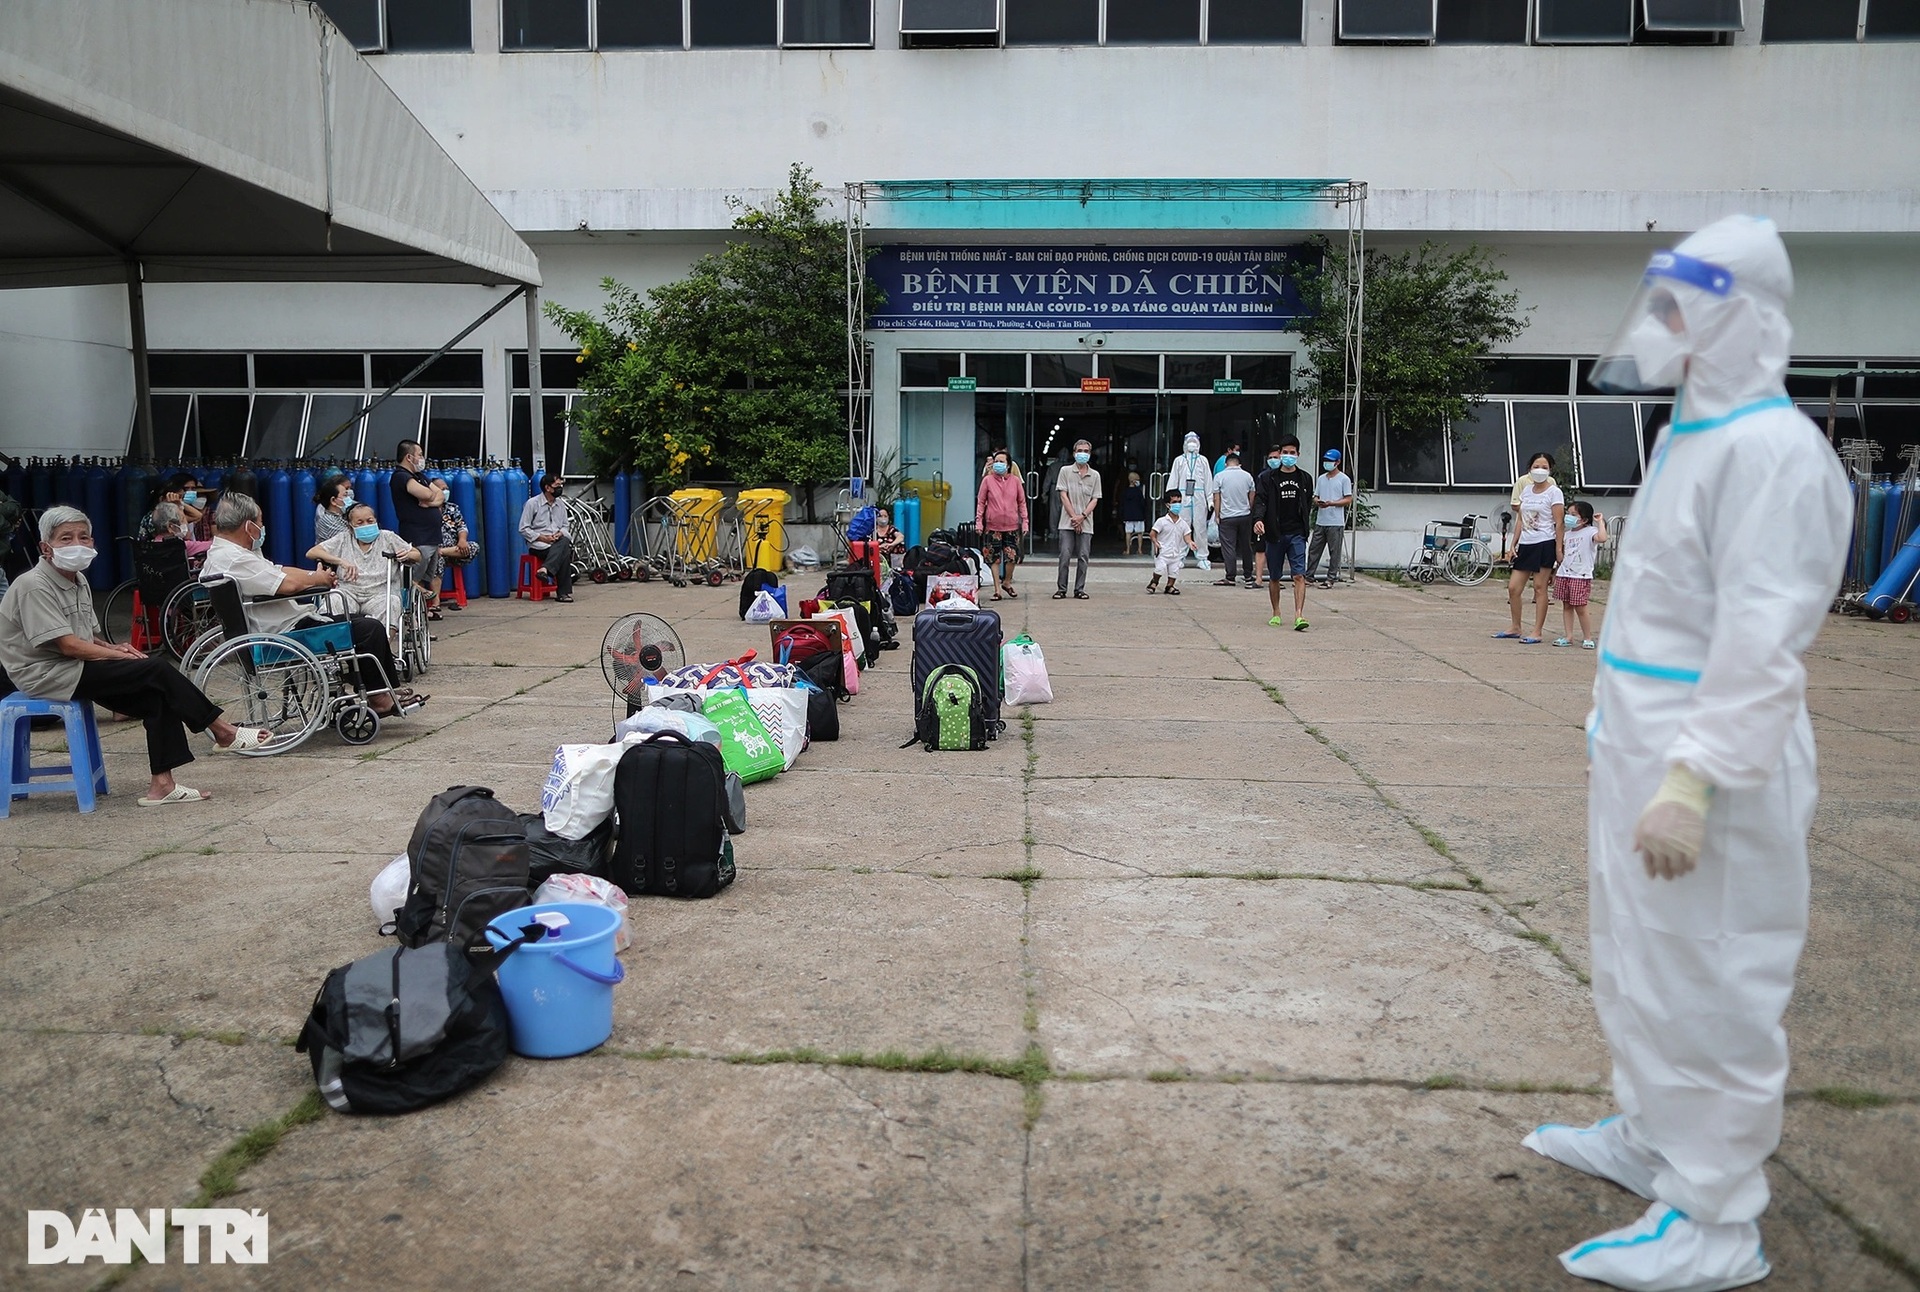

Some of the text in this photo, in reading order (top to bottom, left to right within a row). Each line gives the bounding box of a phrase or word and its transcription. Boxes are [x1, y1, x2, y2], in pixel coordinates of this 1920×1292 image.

[900, 250, 925, 263] BỆNH
[927, 250, 948, 263] VIỆN
[950, 249, 980, 261] THỐNG
[982, 249, 1007, 261] NHẤT
[1015, 252, 1035, 261] BAN
[1037, 249, 1053, 261] CHỈ
[1055, 251, 1074, 264] ĐẠO
[1113, 249, 1145, 261] CHỐNG
[1147, 252, 1169, 264] DỊCH
[1171, 252, 1213, 262] COVID-19
[1215, 250, 1241, 264] QUẬN
[1243, 250, 1262, 261] TÂN
[901, 264, 1285, 300] BỆNH VIỆN DÃ CHIẾN
[945, 302, 966, 314] TRỊ
[969, 301, 1003, 314] BỆNH
[1006, 301, 1044, 312] NHÂN
[1047, 302, 1108, 312] COVID-19
[1111, 303, 1130, 312] ĐA
[1171, 301, 1209, 315] QUẬN
[1212, 301, 1237, 312] TÂN
